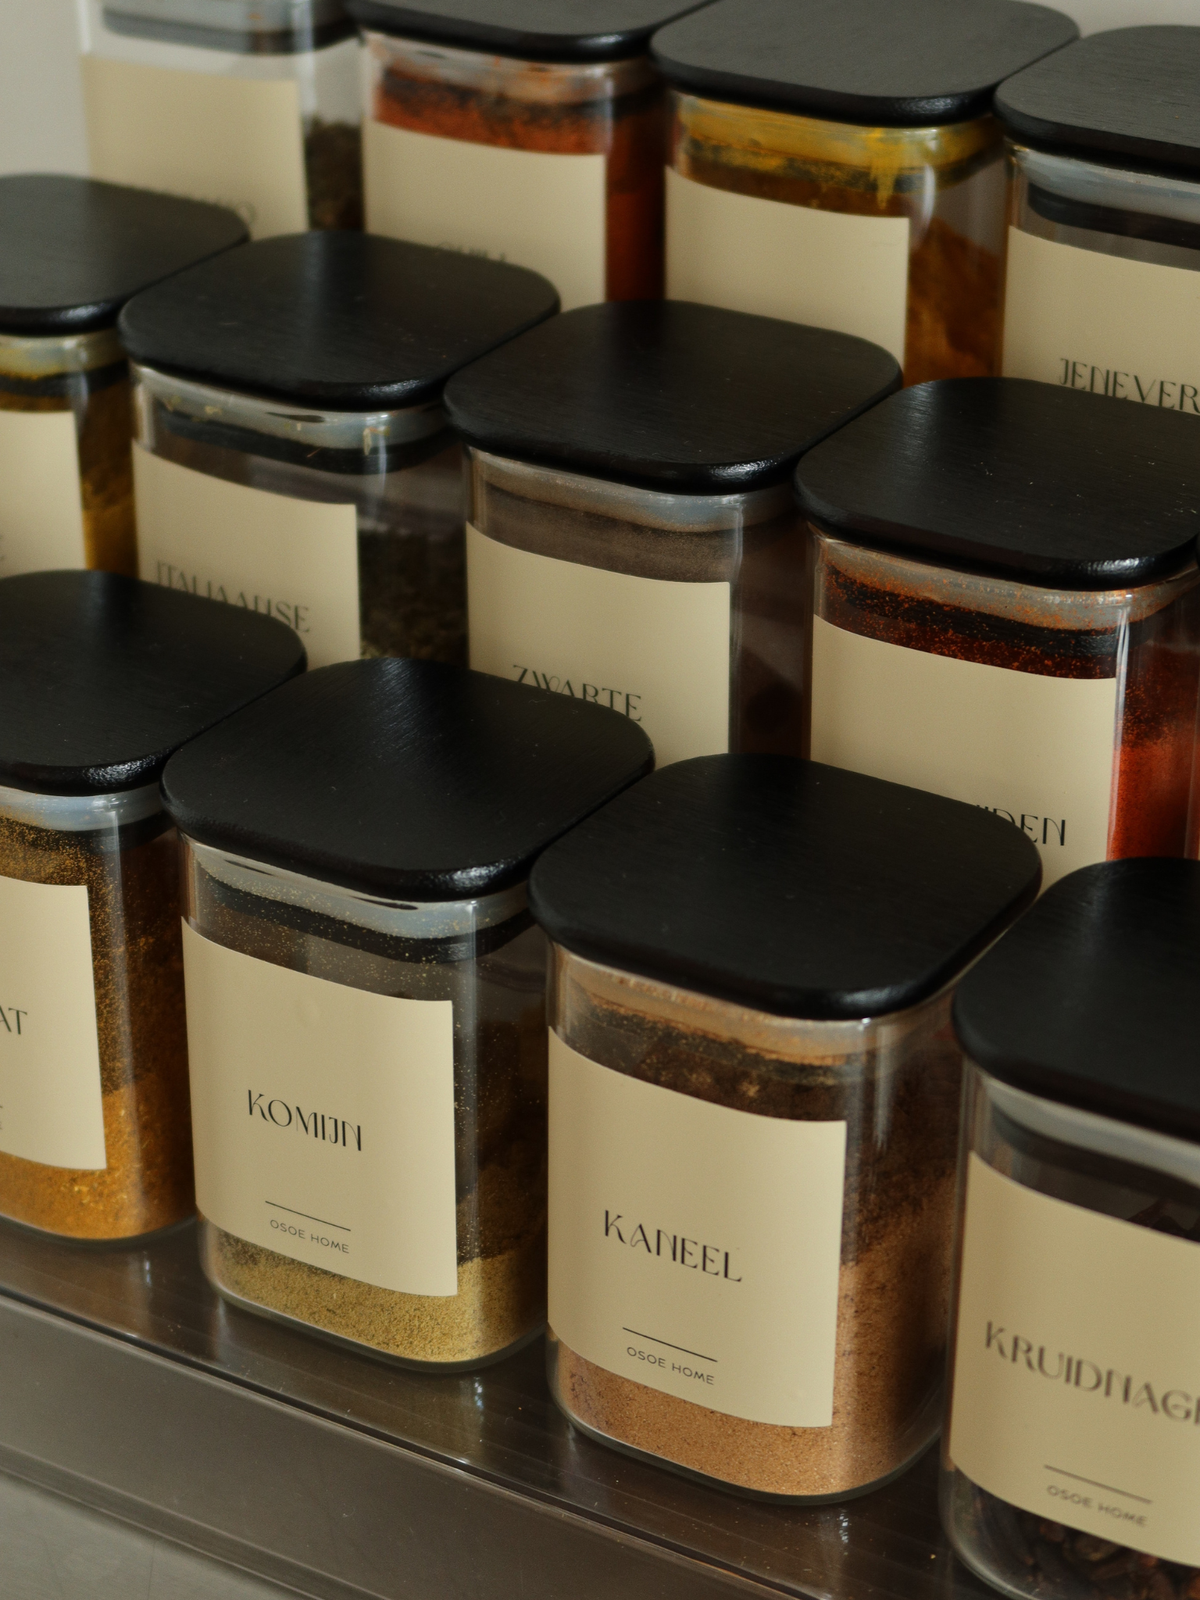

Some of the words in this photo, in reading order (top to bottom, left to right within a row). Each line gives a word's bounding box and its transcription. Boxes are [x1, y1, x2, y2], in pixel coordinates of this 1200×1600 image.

[513, 664, 642, 722] ZWARTE
[248, 1089, 362, 1152] KOMIJN
[269, 1219, 306, 1239] OSOE
[310, 1233, 350, 1254] HOME
[604, 1209, 743, 1283] KANEEL
[626, 1346, 666, 1369] OSOE
[671, 1362, 715, 1386] HOME
[1046, 1484, 1093, 1508] OSOE
[1097, 1502, 1148, 1527] HOME
